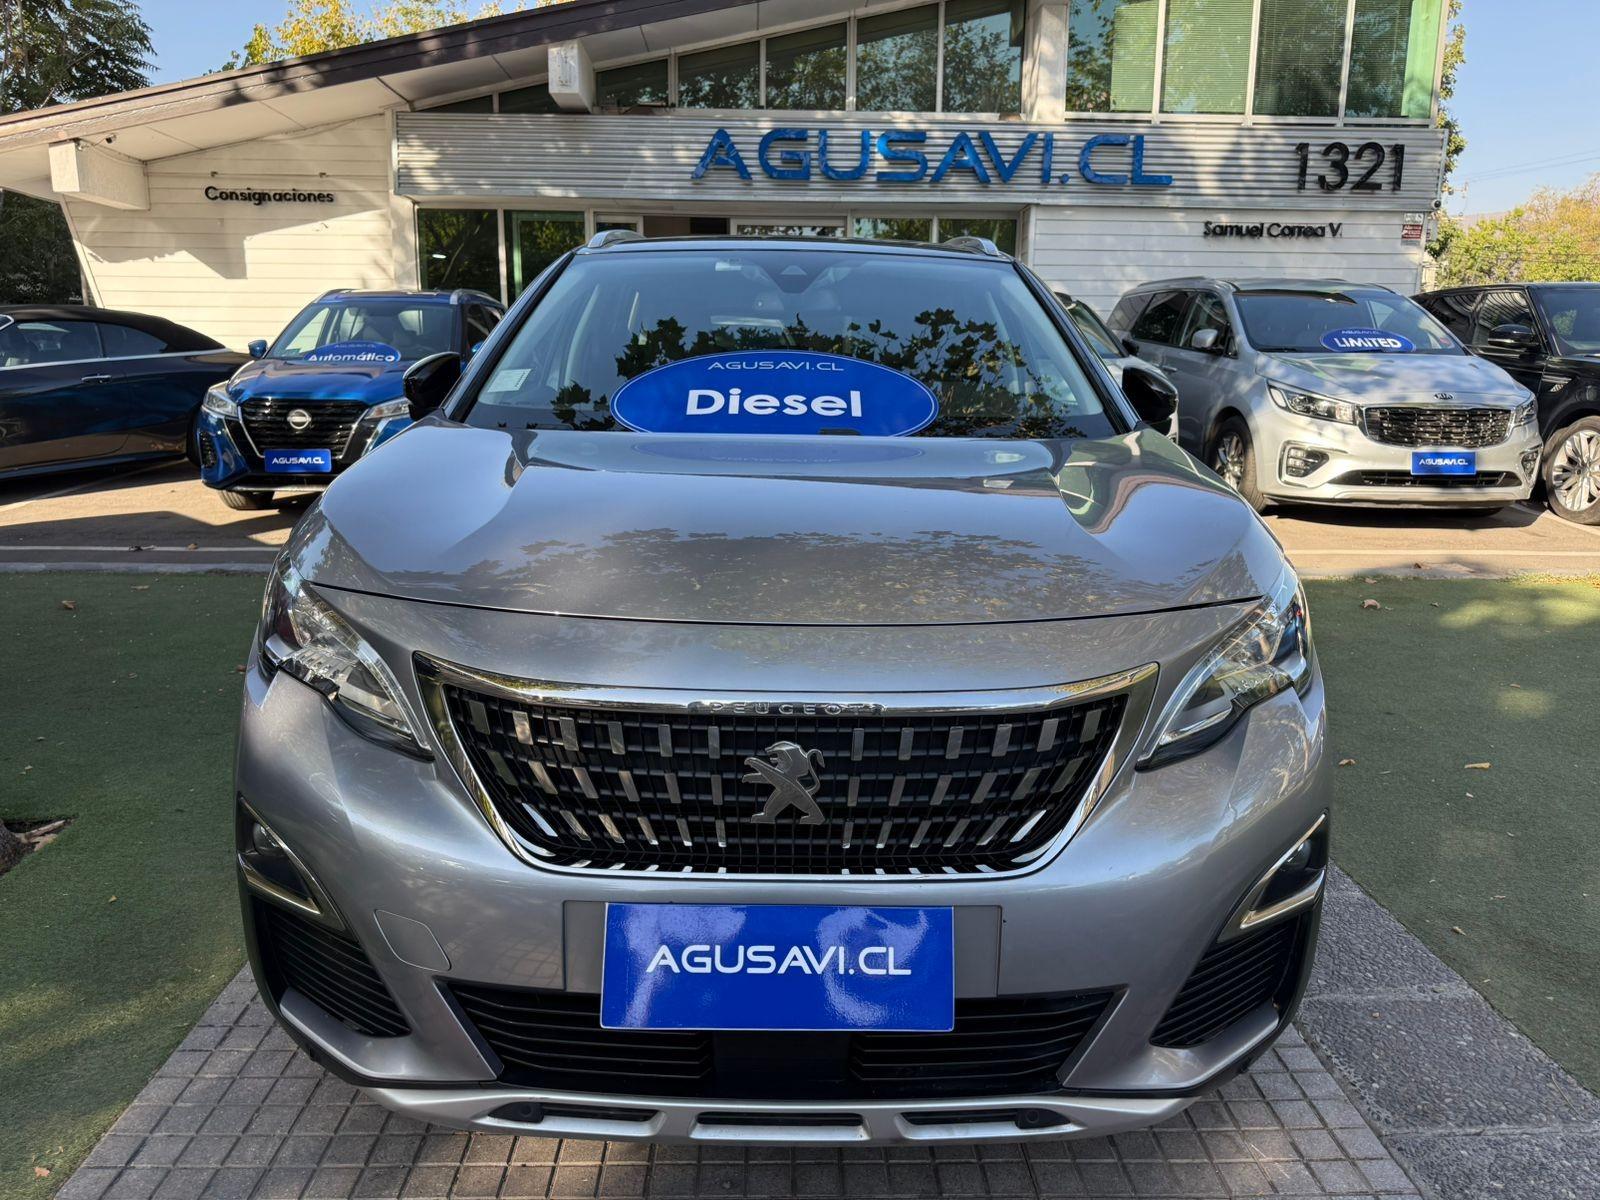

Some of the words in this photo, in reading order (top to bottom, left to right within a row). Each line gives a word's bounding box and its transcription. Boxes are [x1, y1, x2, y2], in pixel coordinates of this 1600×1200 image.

[690, 127, 1173, 186] AGUSAVI.CL
[1295, 141, 1406, 192] 1321
[204, 186, 335, 206] Consignaciones
[1203, 220, 1264, 238] Samuel
[1267, 222, 1326, 238] Correa
[1333, 337, 1403, 348] LIMITED
[308, 351, 396, 362] Automático
[707, 360, 844, 372] AGUSAVI.CL
[686, 387, 863, 418] Diesel
[271, 456, 326, 465] AGUSAVI.CL
[1418, 458, 1469, 466] AGUSAVI.CL
[709, 701, 866, 716] PEUGEOT
[645, 943, 913, 976] AGUSAVI.CL
